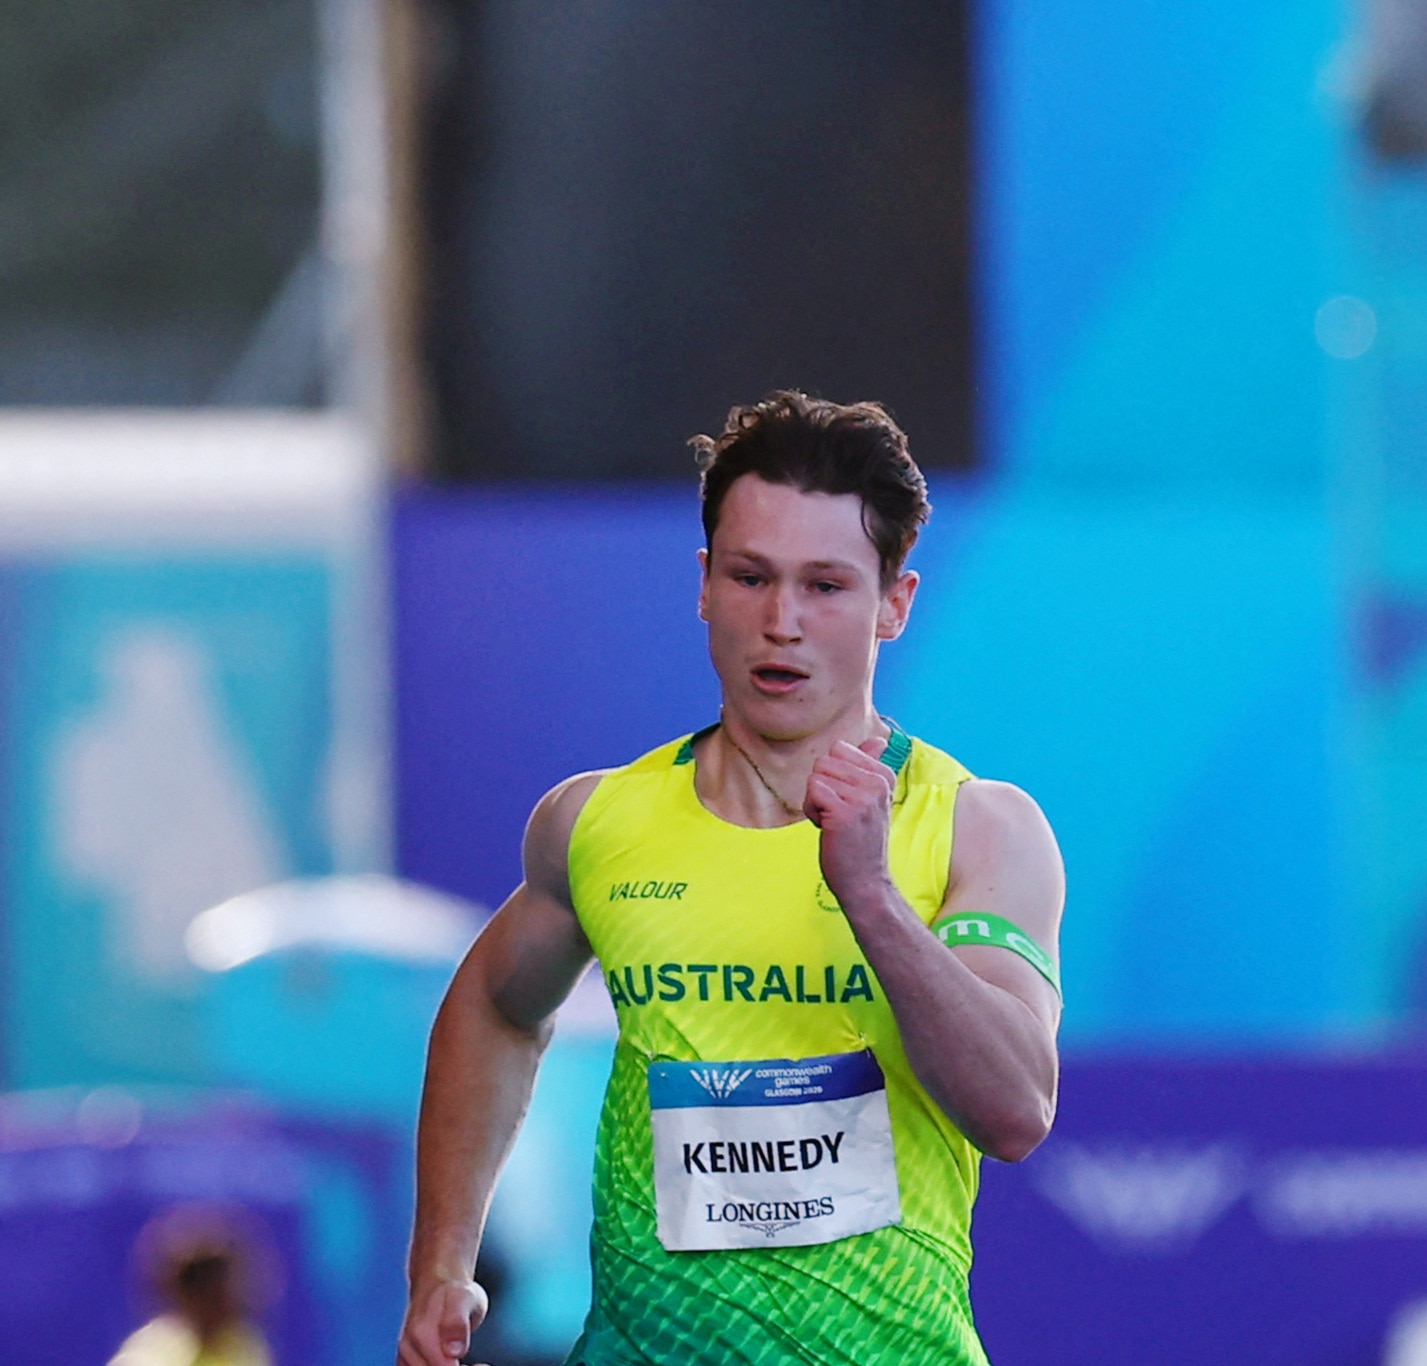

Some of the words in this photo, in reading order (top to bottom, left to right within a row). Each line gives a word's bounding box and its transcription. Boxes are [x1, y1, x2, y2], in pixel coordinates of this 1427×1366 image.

[608, 880, 688, 902] VALOUR
[606, 963, 875, 1010] AUSTRALIA
[754, 1064, 833, 1079] commonwealth
[774, 1075, 811, 1089] games
[683, 1131, 846, 1175] KENNEDY
[705, 1196, 836, 1224] LONGINES
